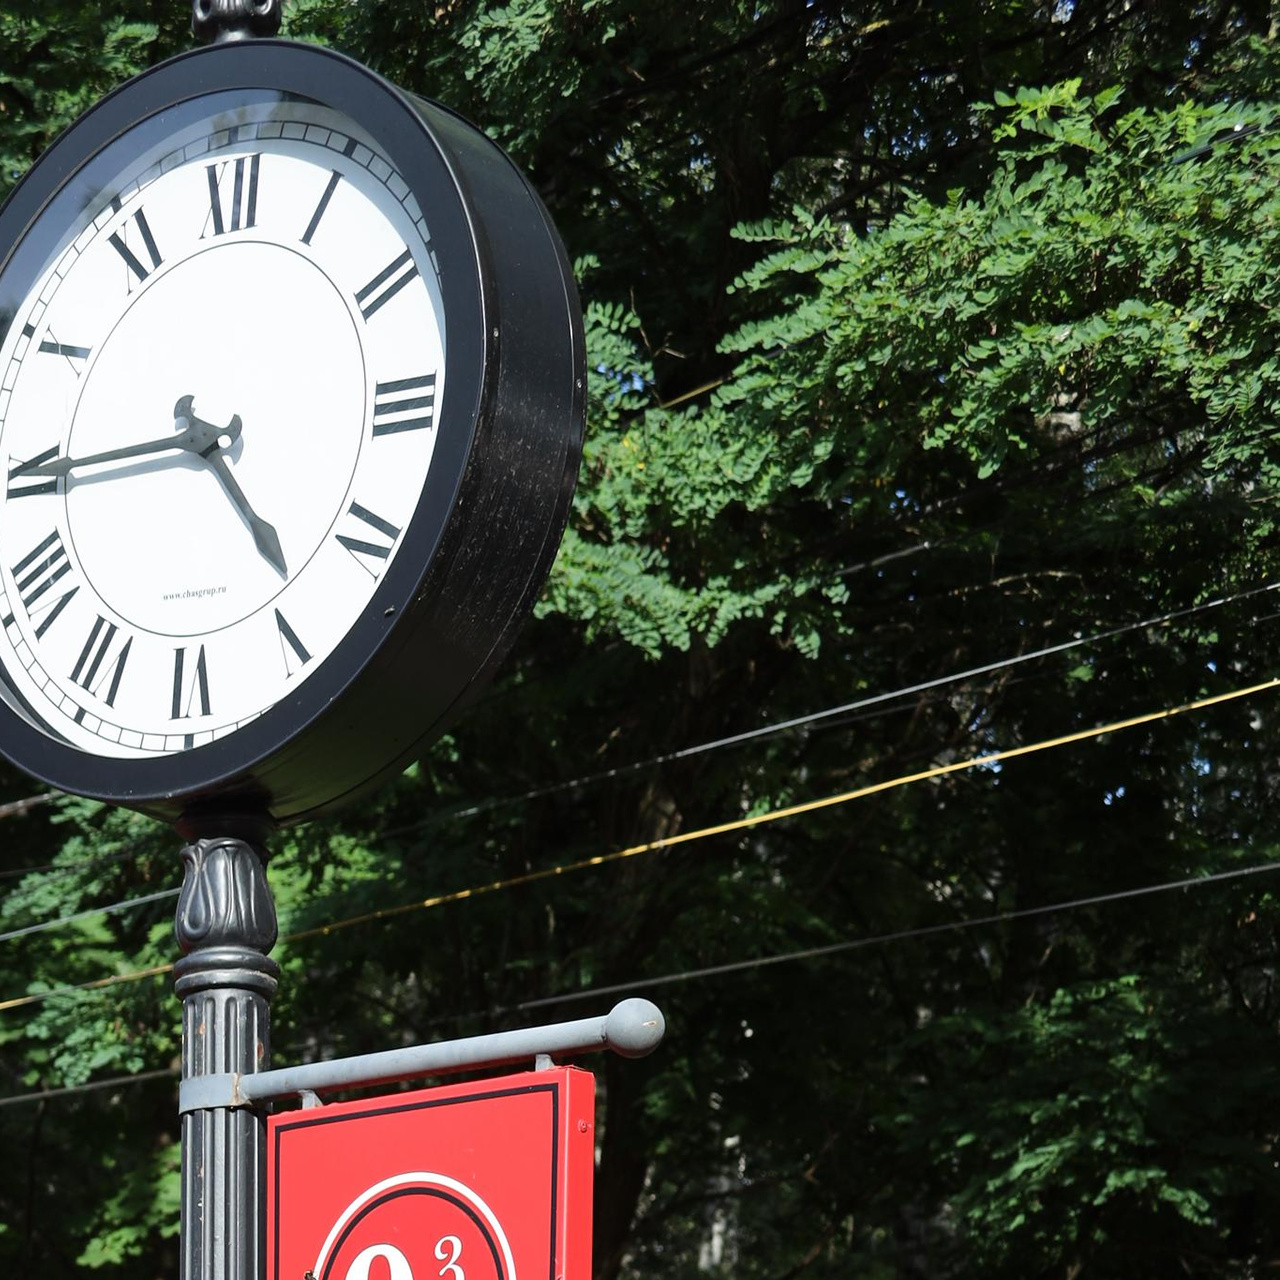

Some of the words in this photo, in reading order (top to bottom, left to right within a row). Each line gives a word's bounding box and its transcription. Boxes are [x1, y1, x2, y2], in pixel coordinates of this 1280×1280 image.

[199, 152, 264, 239] XII
[299, 169, 345, 247] I
[106, 204, 165, 296] XI
[353, 244, 421, 324] II
[37, 324, 93, 379] X
[372, 369, 437, 441] III
[335, 497, 403, 584] IV
[10, 526, 80, 643] VIII
[67, 614, 133, 709] VII
[169, 644, 213, 720] VI
[274, 607, 314, 680] V
